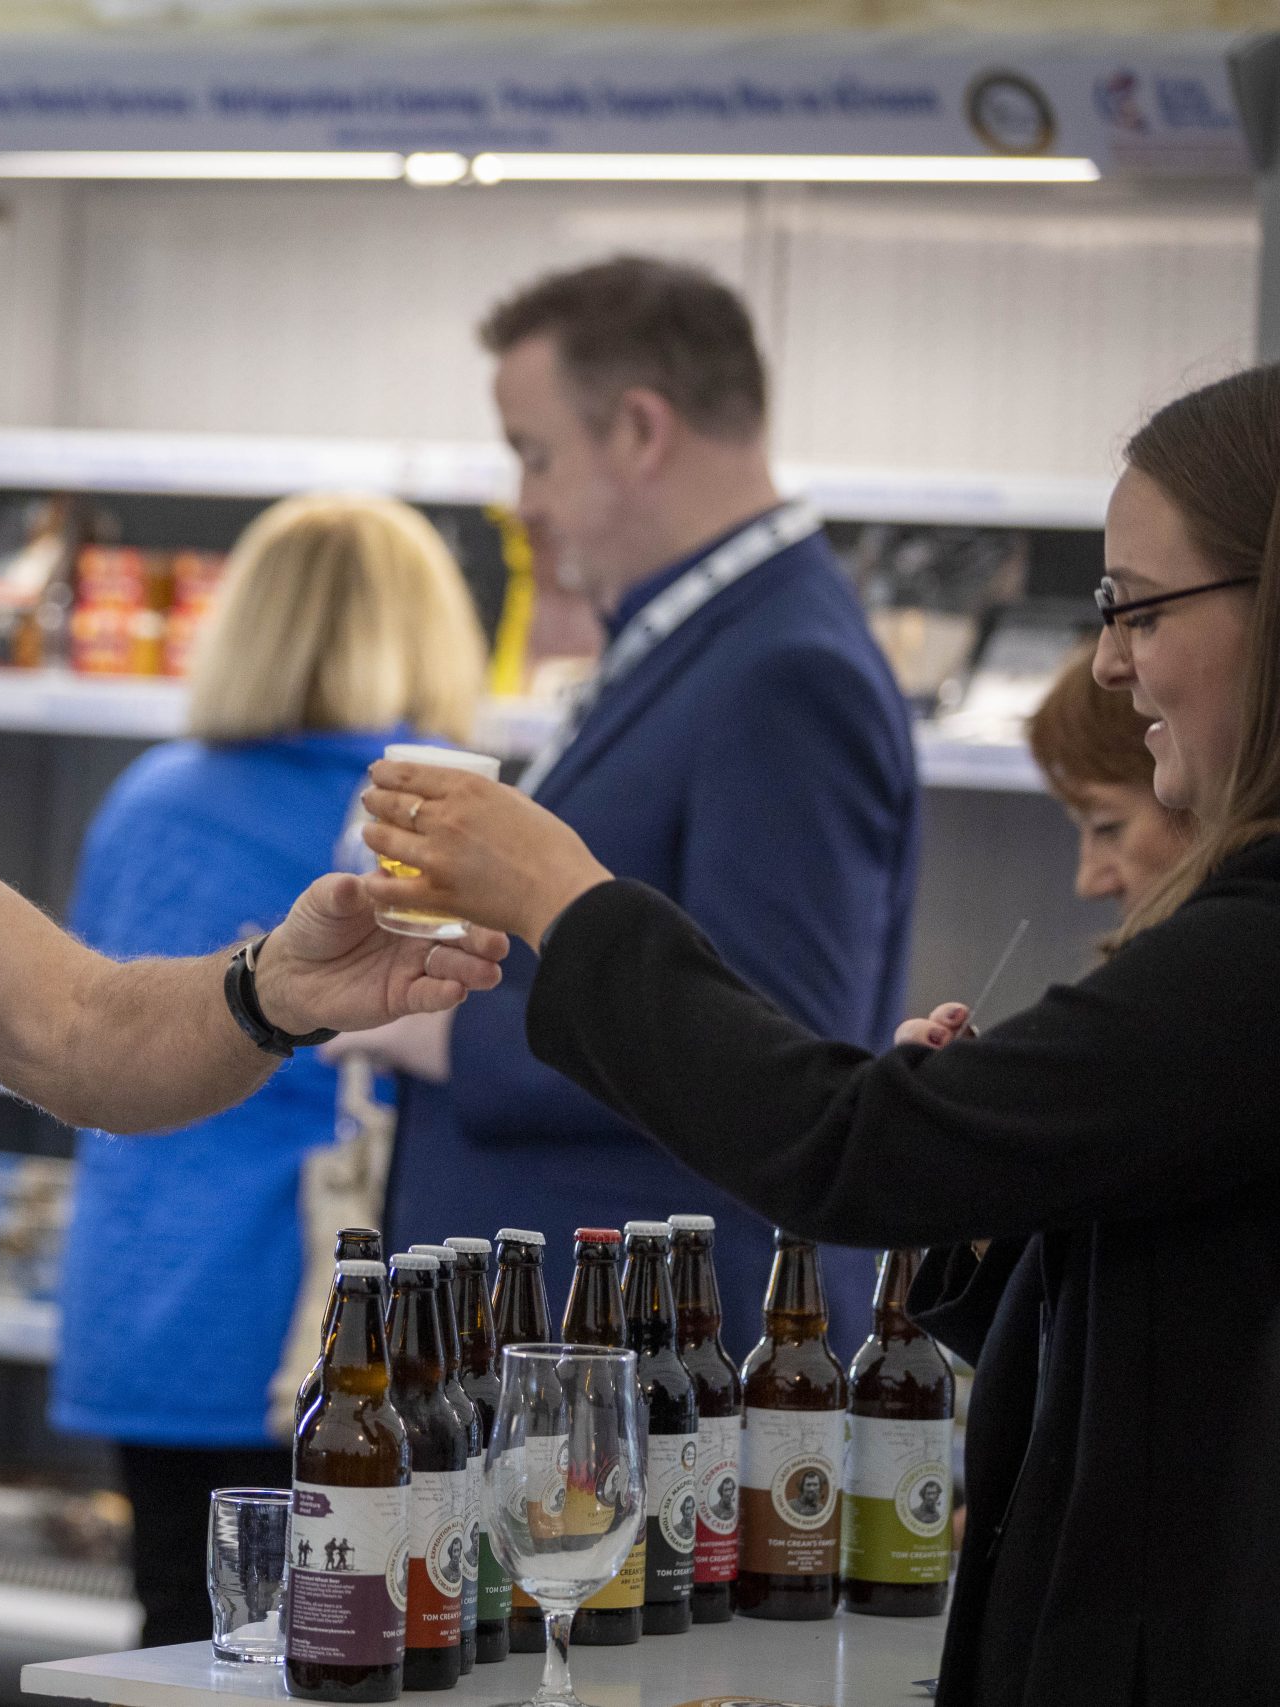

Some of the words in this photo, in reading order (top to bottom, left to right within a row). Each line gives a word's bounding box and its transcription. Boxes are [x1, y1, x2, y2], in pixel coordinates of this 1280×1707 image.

[702, 1461, 728, 1486] CORNER
[664, 1498, 672, 1509] SIX
[431, 1524, 452, 1559] EXPEDITION
[431, 1566, 439, 1580] TOM
